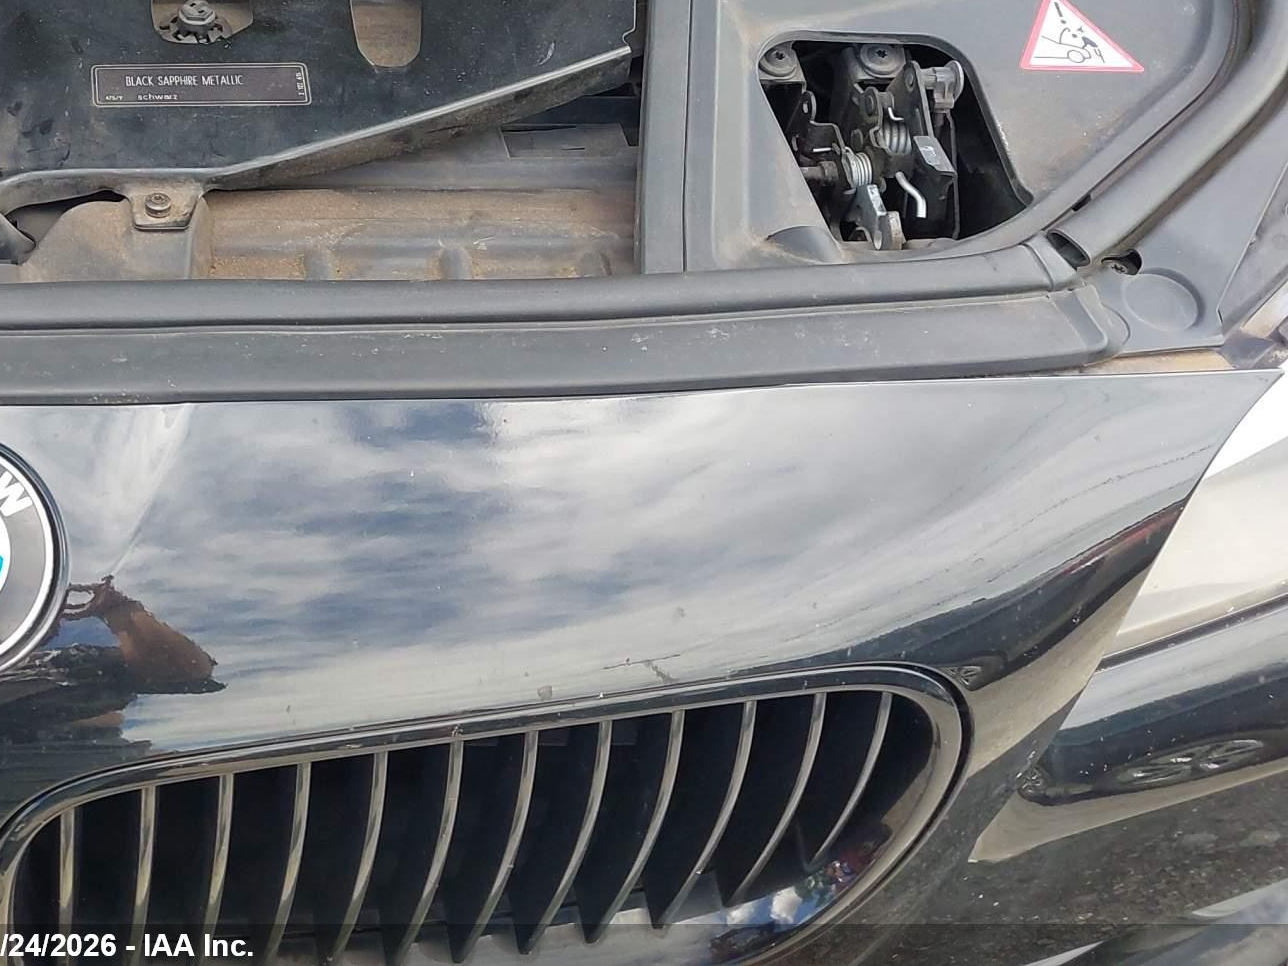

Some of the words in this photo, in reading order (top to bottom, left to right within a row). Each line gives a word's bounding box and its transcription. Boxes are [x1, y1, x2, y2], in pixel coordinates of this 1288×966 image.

[125, 75, 154, 87] BLACK
[157, 75, 198, 87] SAPPHIRE
[201, 75, 245, 86] METALLIC
[137, 93, 179, 101] schwarz
